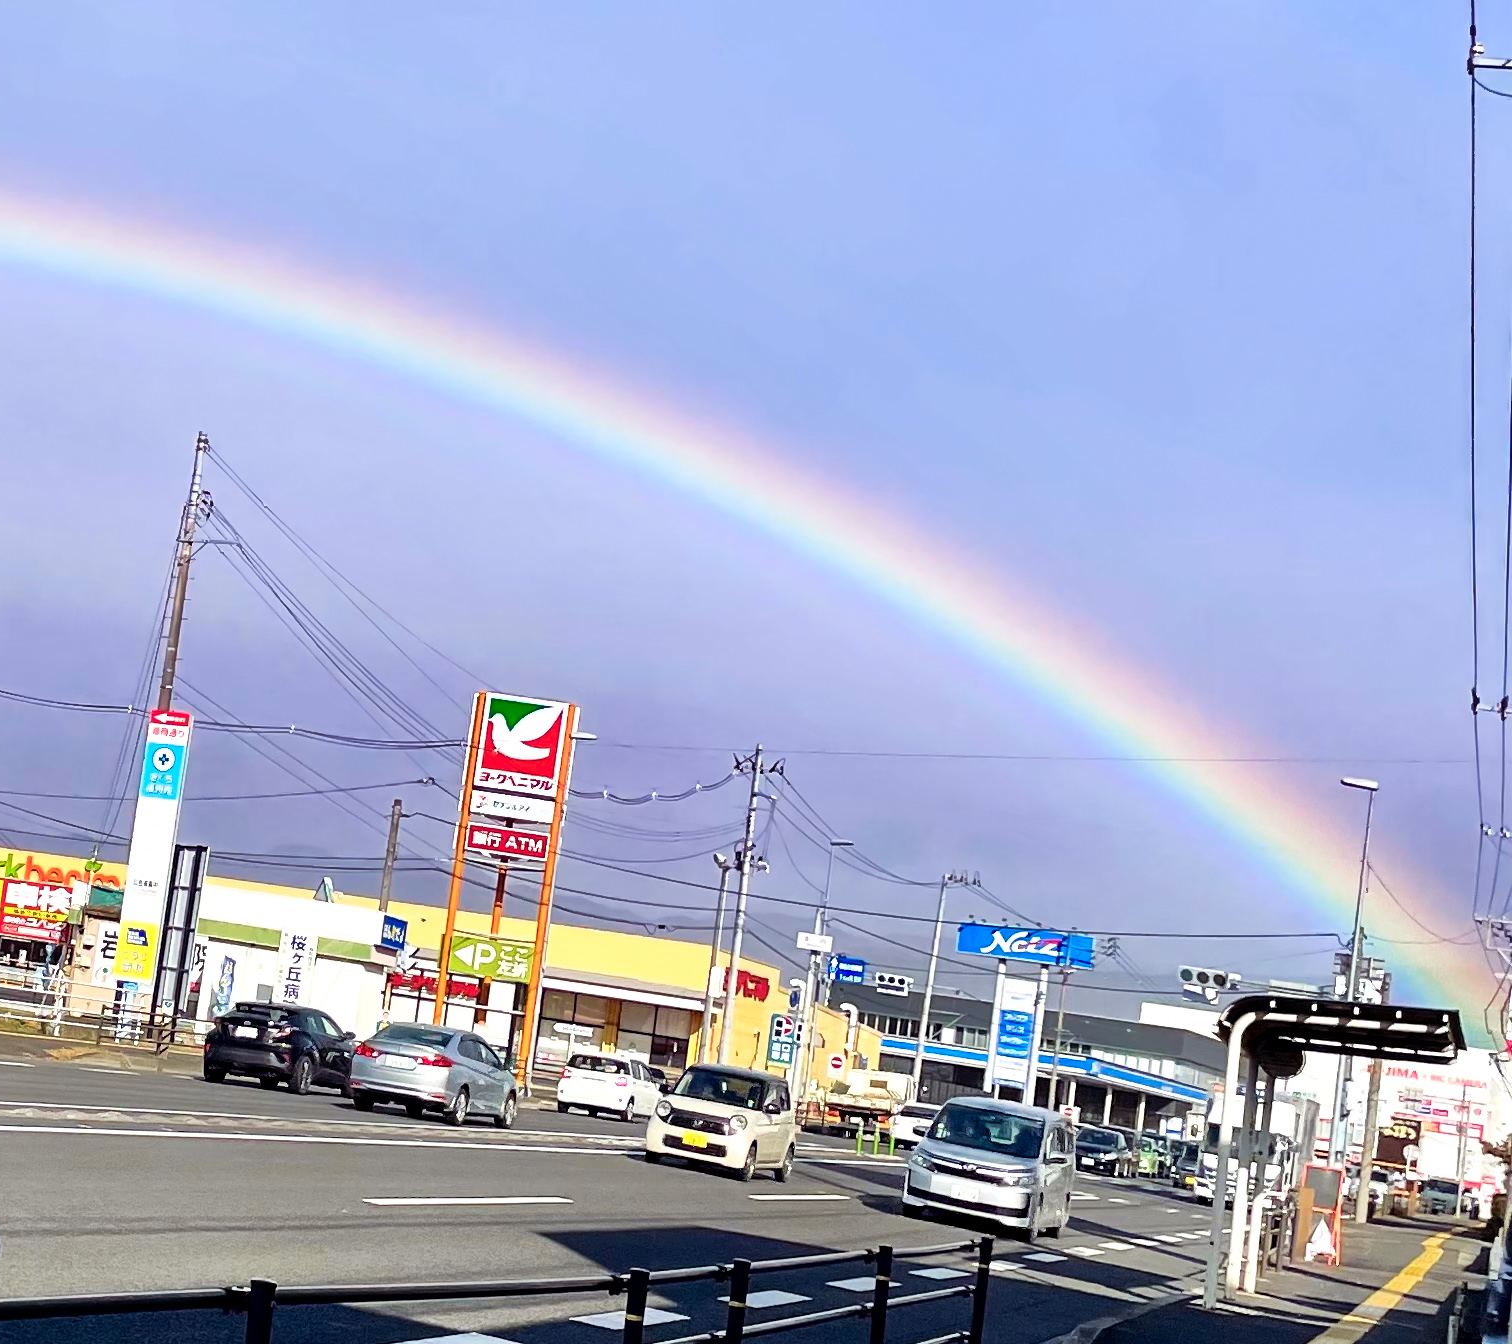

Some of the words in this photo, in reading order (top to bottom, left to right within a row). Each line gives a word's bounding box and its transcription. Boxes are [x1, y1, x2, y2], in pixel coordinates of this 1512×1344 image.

[472, 830, 502, 848] 銀行
[505, 835, 543, 853] ATM
[5, 882, 74, 914] 車検
[499, 946, 529, 964] ここ
[980, 930, 1065, 957] Netz
[283, 934, 307, 1004] 桜ヶ丘病
[473, 942, 497, 971] P
[496, 960, 529, 979] 左折
[1366, 1064, 1419, 1080] JIMA
